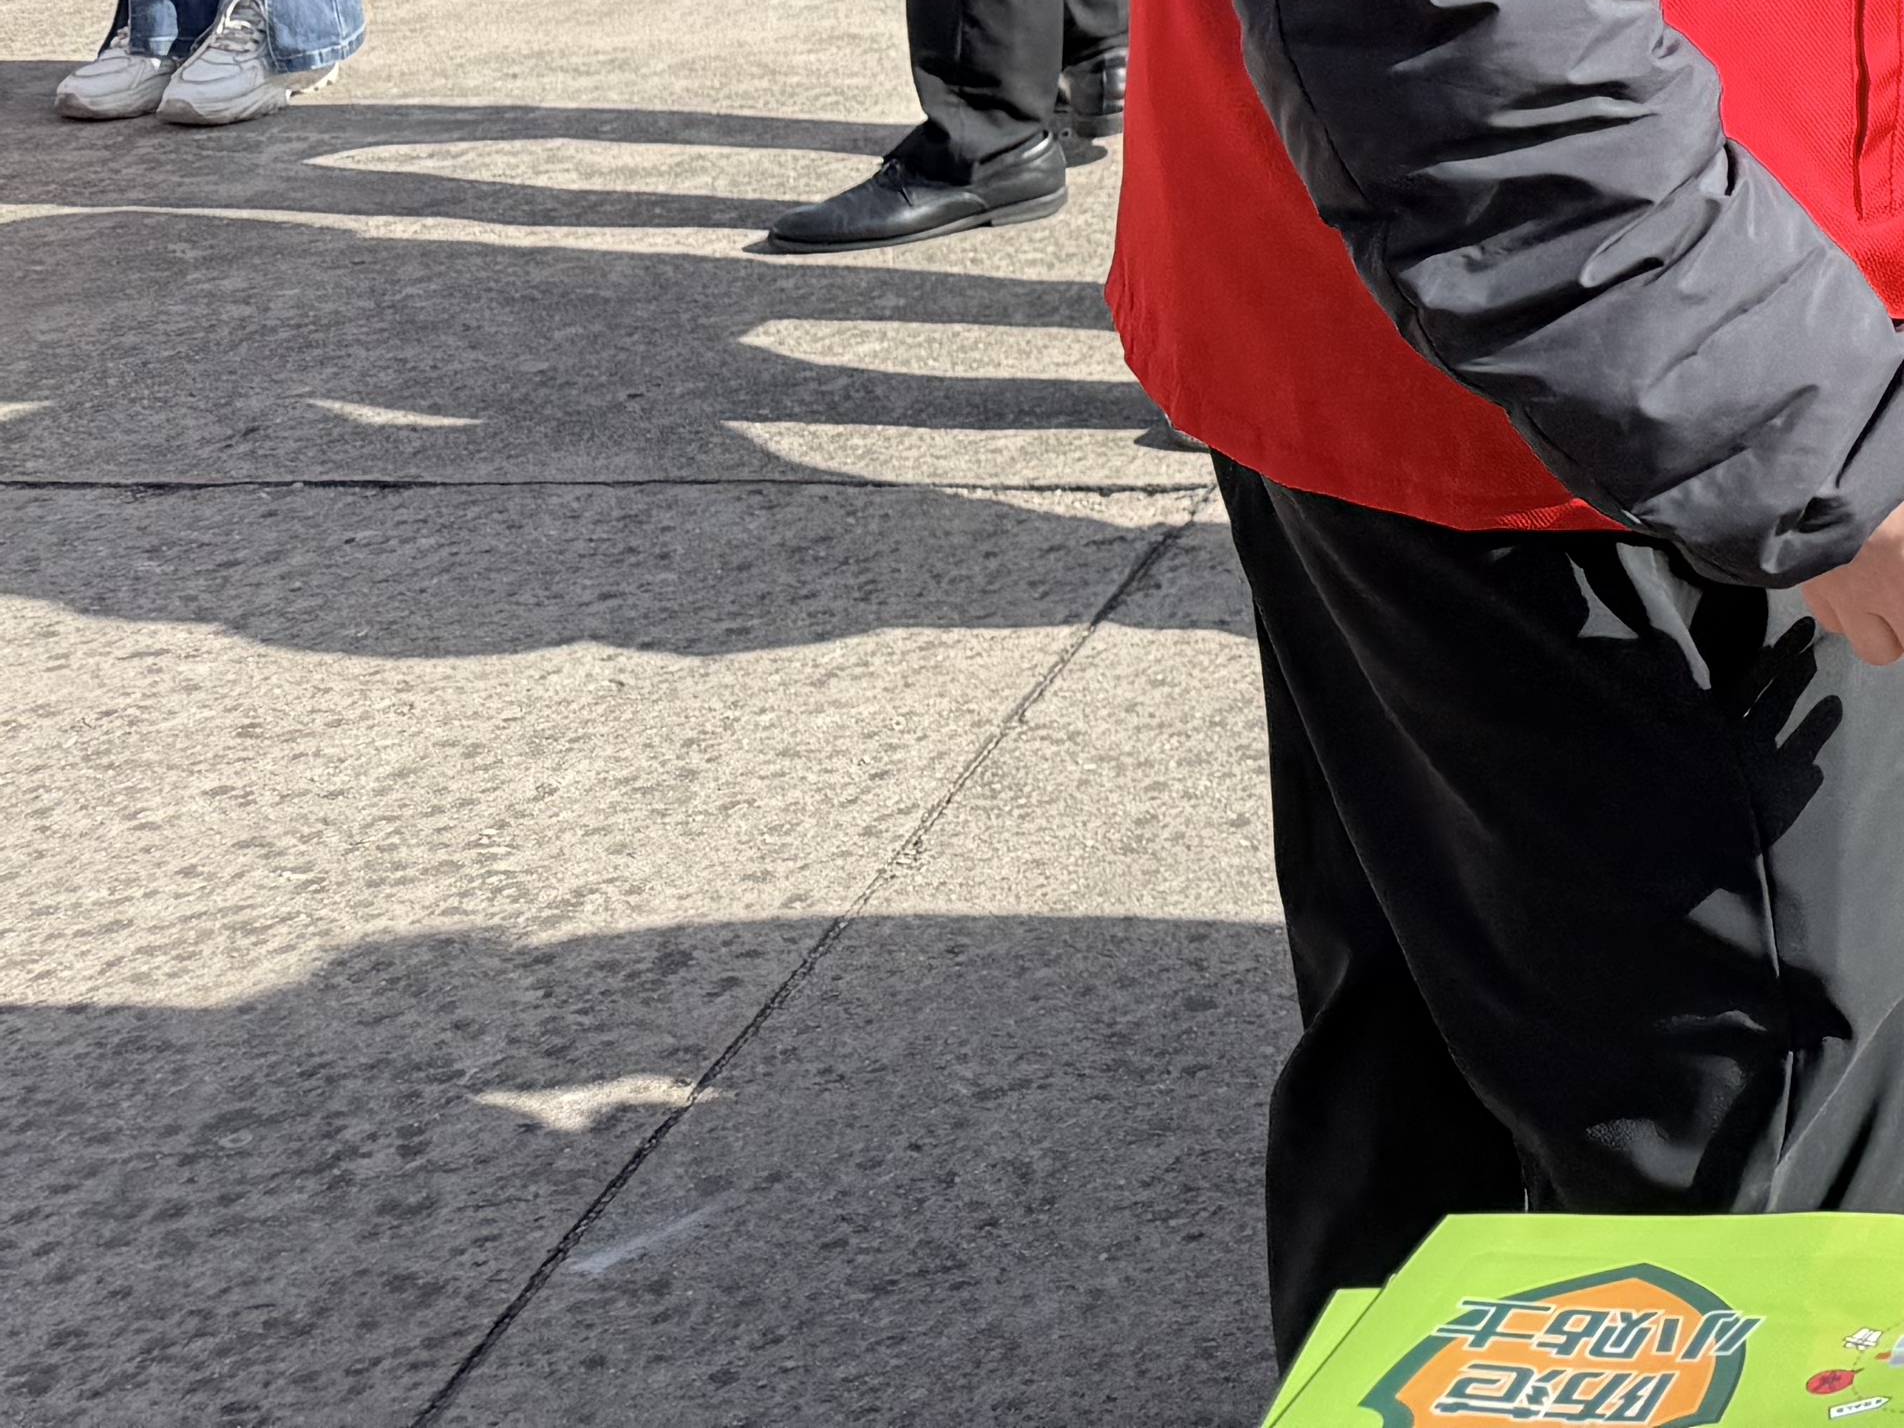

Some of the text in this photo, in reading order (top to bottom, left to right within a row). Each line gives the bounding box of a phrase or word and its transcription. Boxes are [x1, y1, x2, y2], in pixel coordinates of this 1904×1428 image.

[1430, 1295, 1768, 1363] 小贴士
[1429, 1360, 1681, 1425] 防范
